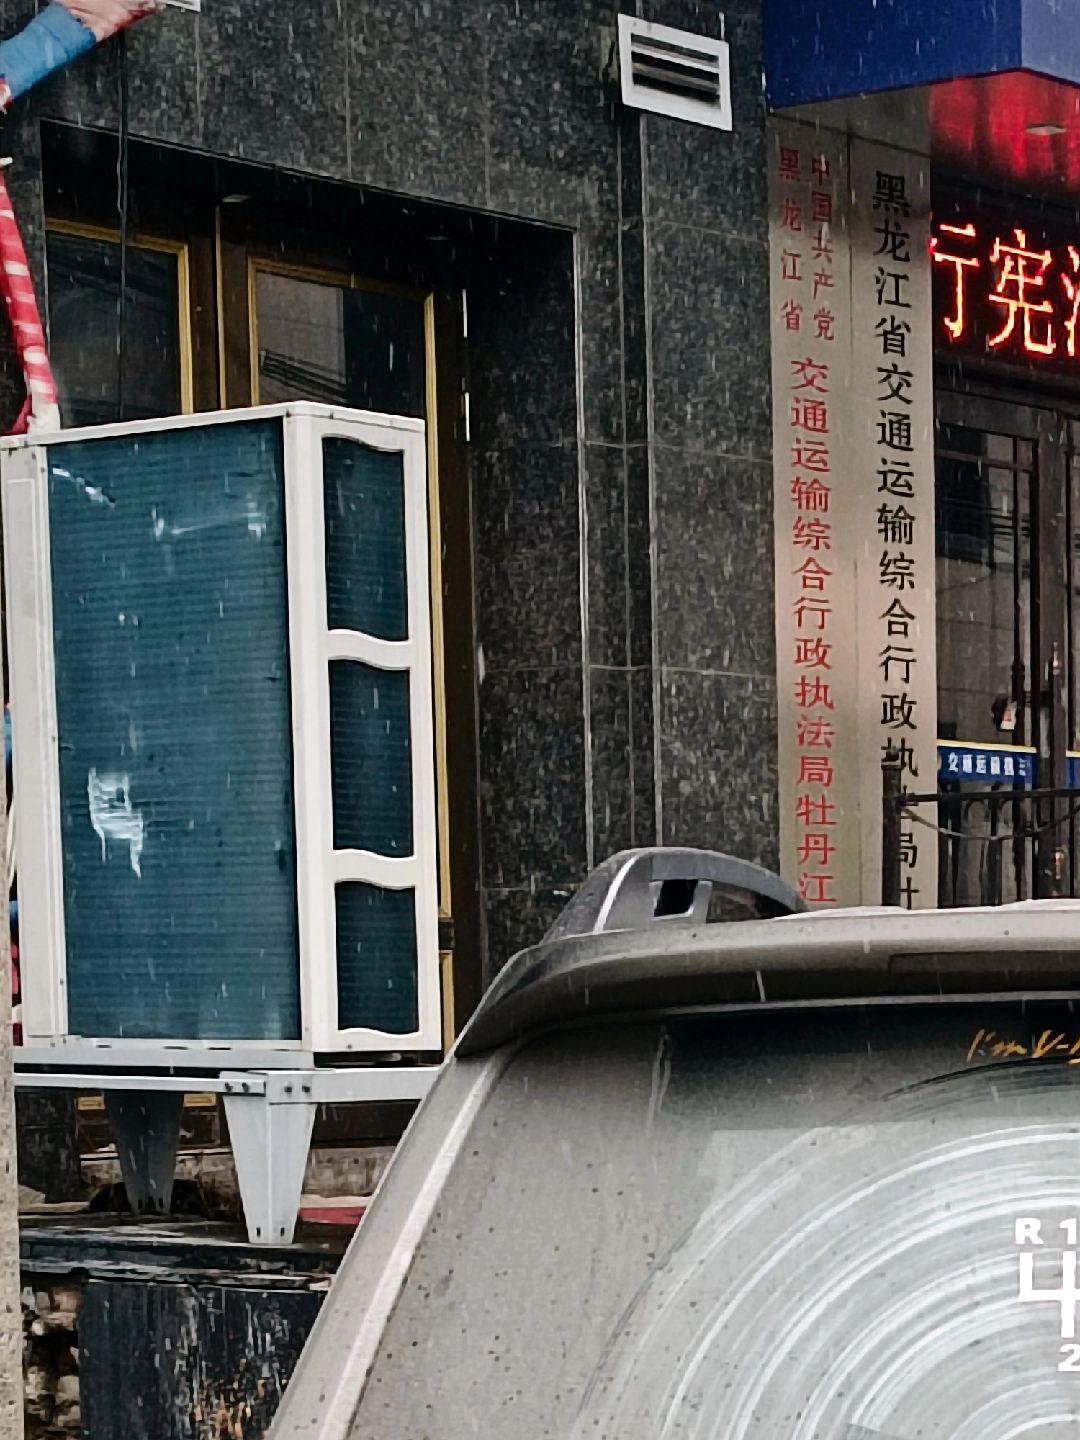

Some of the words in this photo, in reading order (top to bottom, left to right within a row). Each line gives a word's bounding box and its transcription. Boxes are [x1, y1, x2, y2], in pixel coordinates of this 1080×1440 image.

[779, 146, 803, 333] 黑龙江省
[811, 154, 835, 341] 中国共产党
[789, 357, 837, 903] 交通运输综合行政执法局牡丹江
[1014, 1216, 1044, 1245] R
[1058, 1217, 1078, 1245] 1
